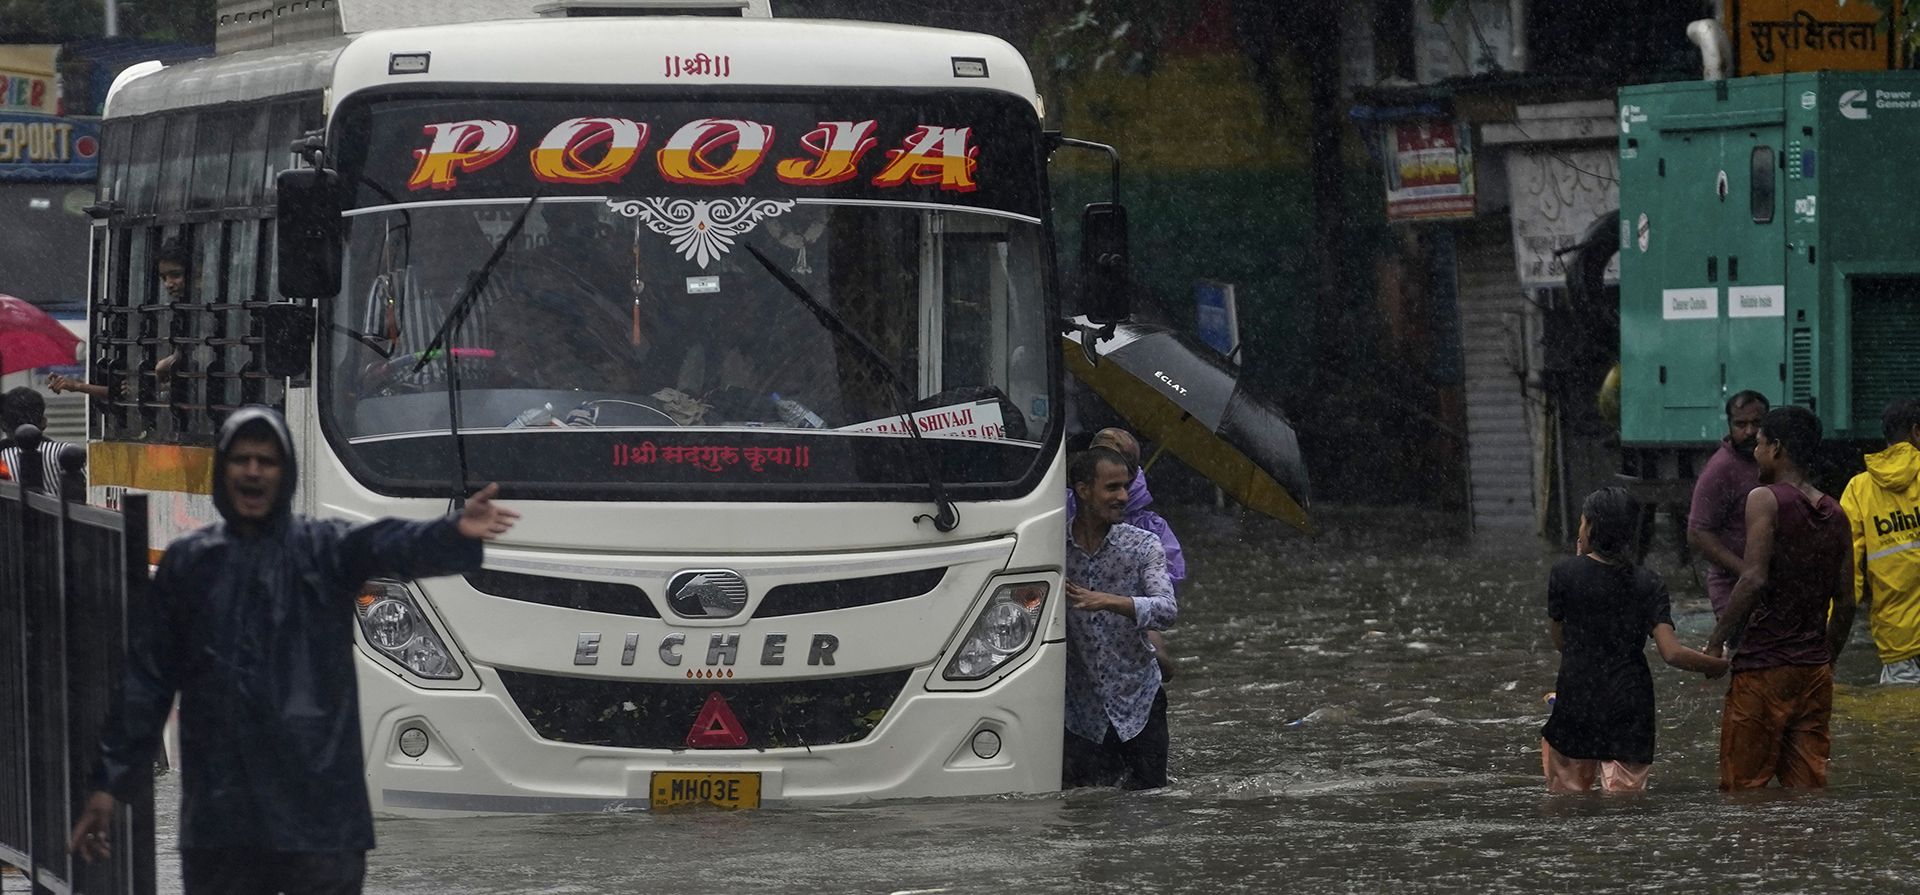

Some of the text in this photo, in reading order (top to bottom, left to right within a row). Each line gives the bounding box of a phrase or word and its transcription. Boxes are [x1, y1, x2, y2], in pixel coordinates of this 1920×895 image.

[1749, 10, 1876, 63] सुरक्षितता
[1875, 89, 1912, 99] Power
[406, 117, 978, 192] POOJA
[918, 408, 974, 433] SHIVAJI
[573, 632, 840, 666] EICHER
[671, 778, 740, 801] MH03E
